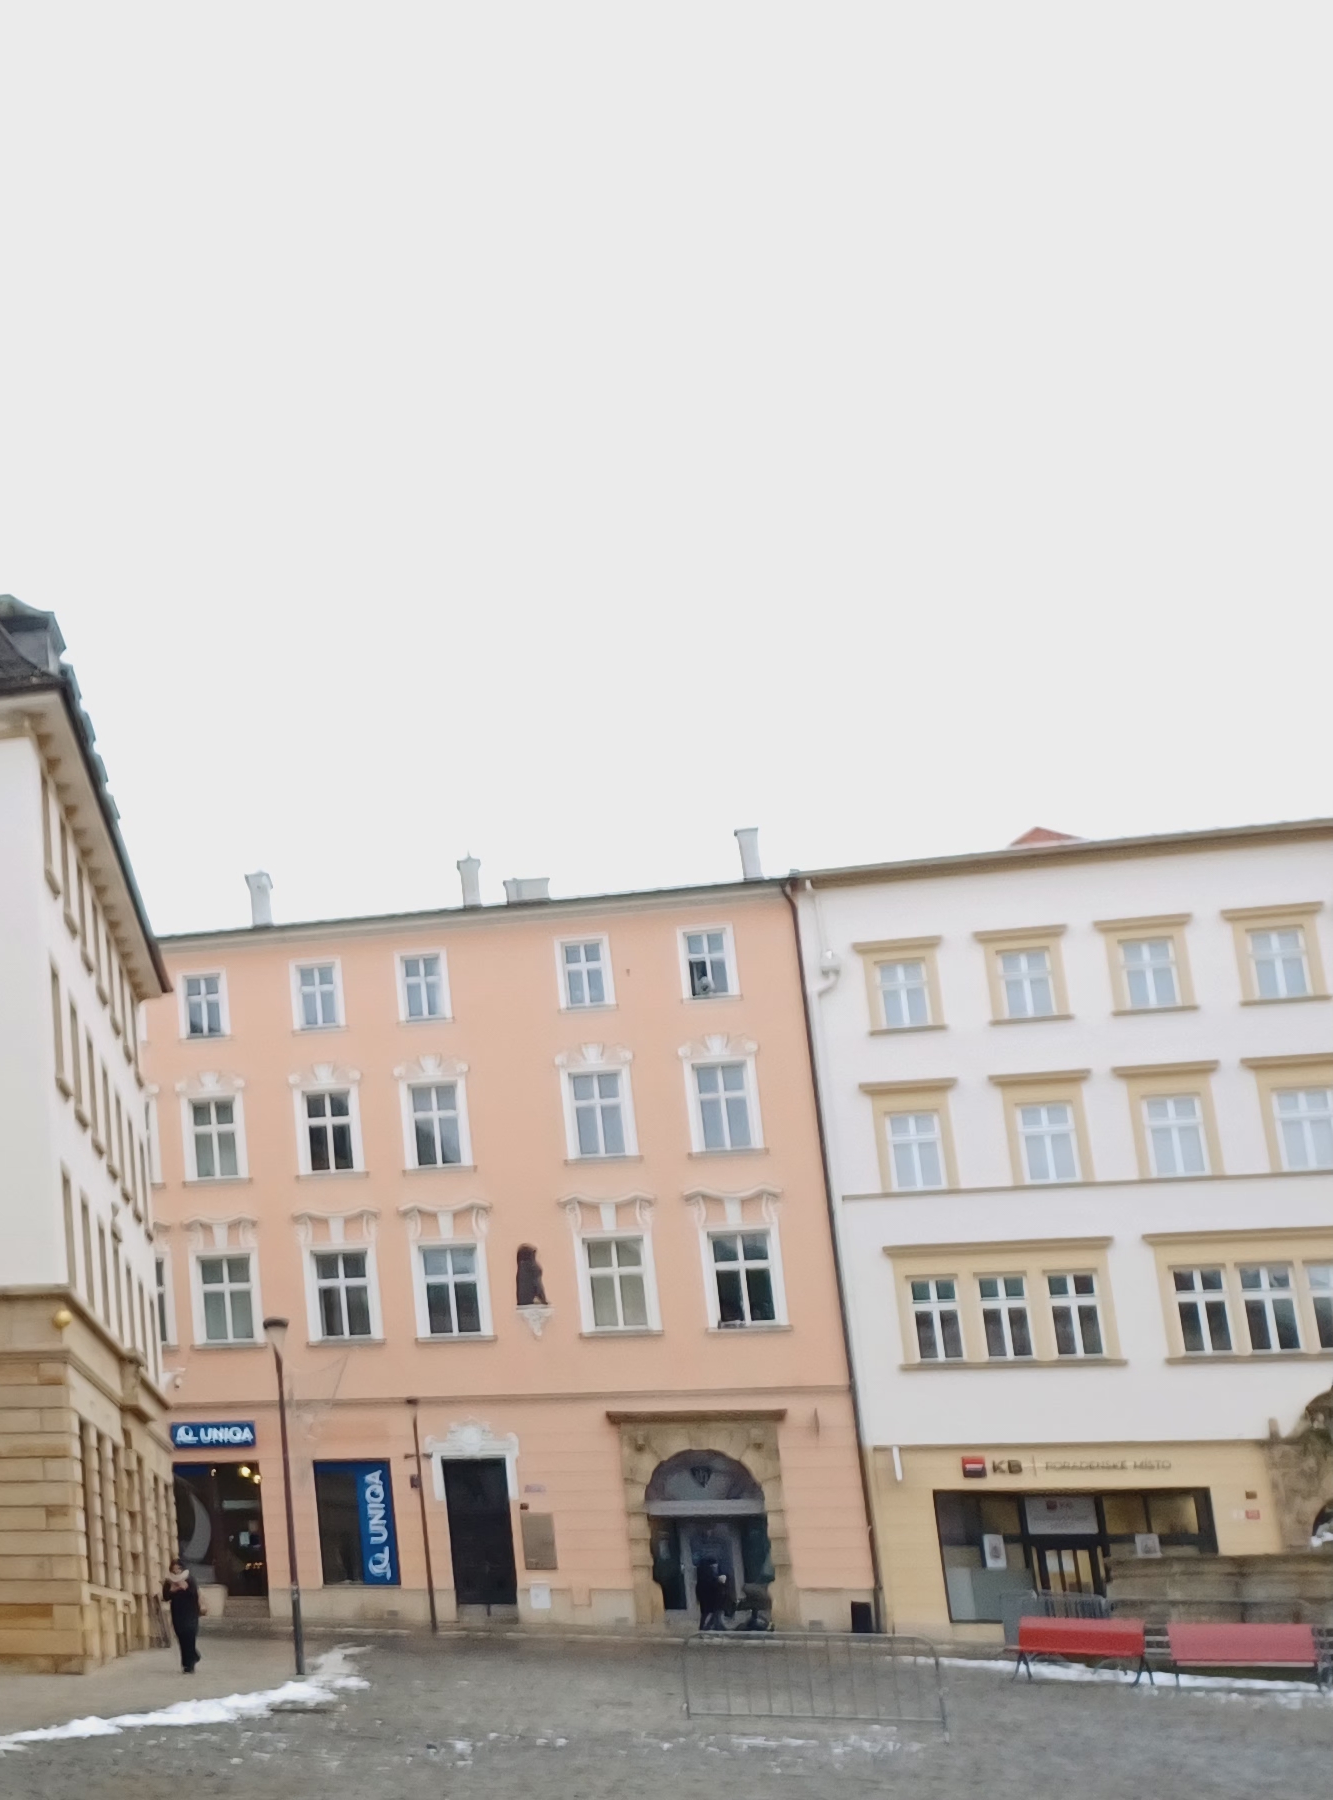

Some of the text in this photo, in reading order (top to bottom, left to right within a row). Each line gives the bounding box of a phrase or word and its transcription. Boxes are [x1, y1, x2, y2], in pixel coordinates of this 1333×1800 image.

[199, 1427, 254, 1443] UNIQA
[992, 1460, 1023, 1474] KB
[365, 1469, 388, 1545] UNIQA
